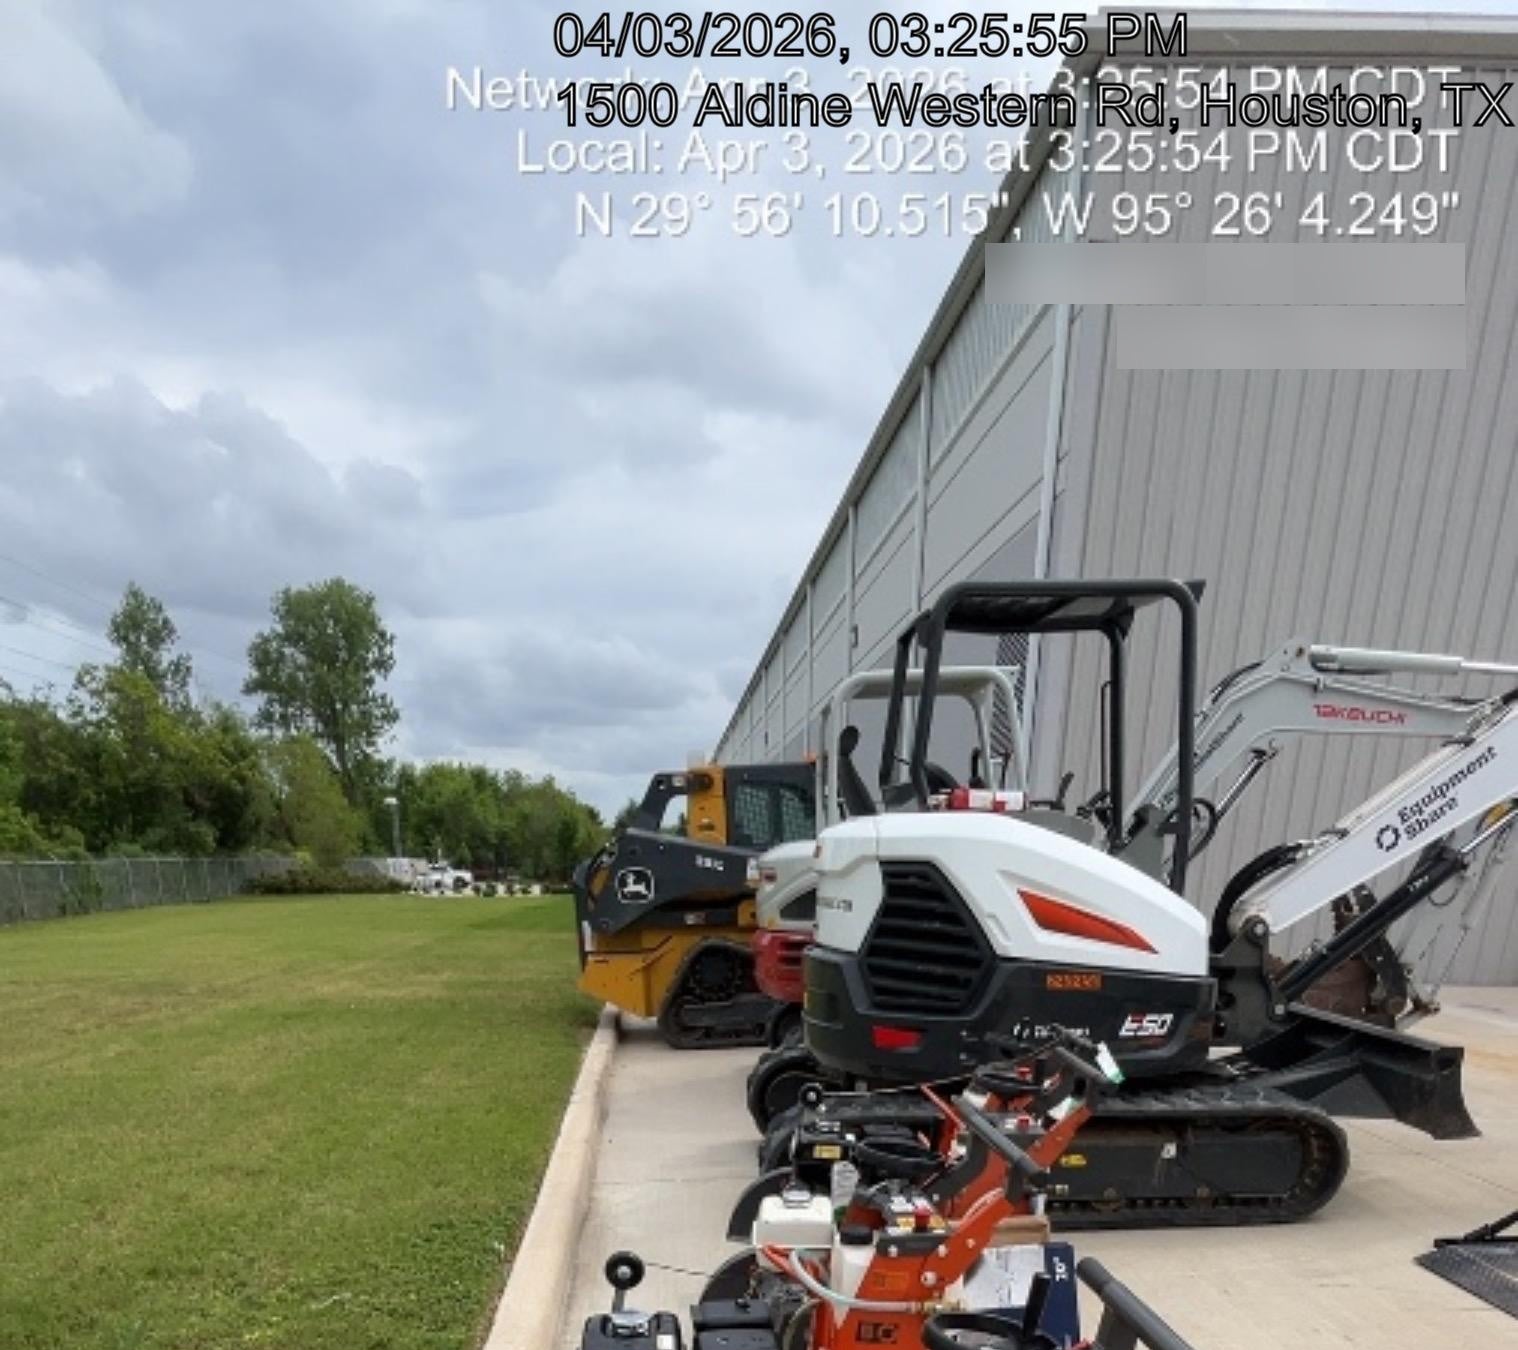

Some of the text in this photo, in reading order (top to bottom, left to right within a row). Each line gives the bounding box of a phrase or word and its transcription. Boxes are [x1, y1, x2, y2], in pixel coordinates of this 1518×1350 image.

[1313, 704, 1408, 724] TAKEUCHI
[1396, 745, 1499, 825] Equipment
[1403, 796, 1460, 841] Share
[1119, 1013, 1175, 1037] E50
